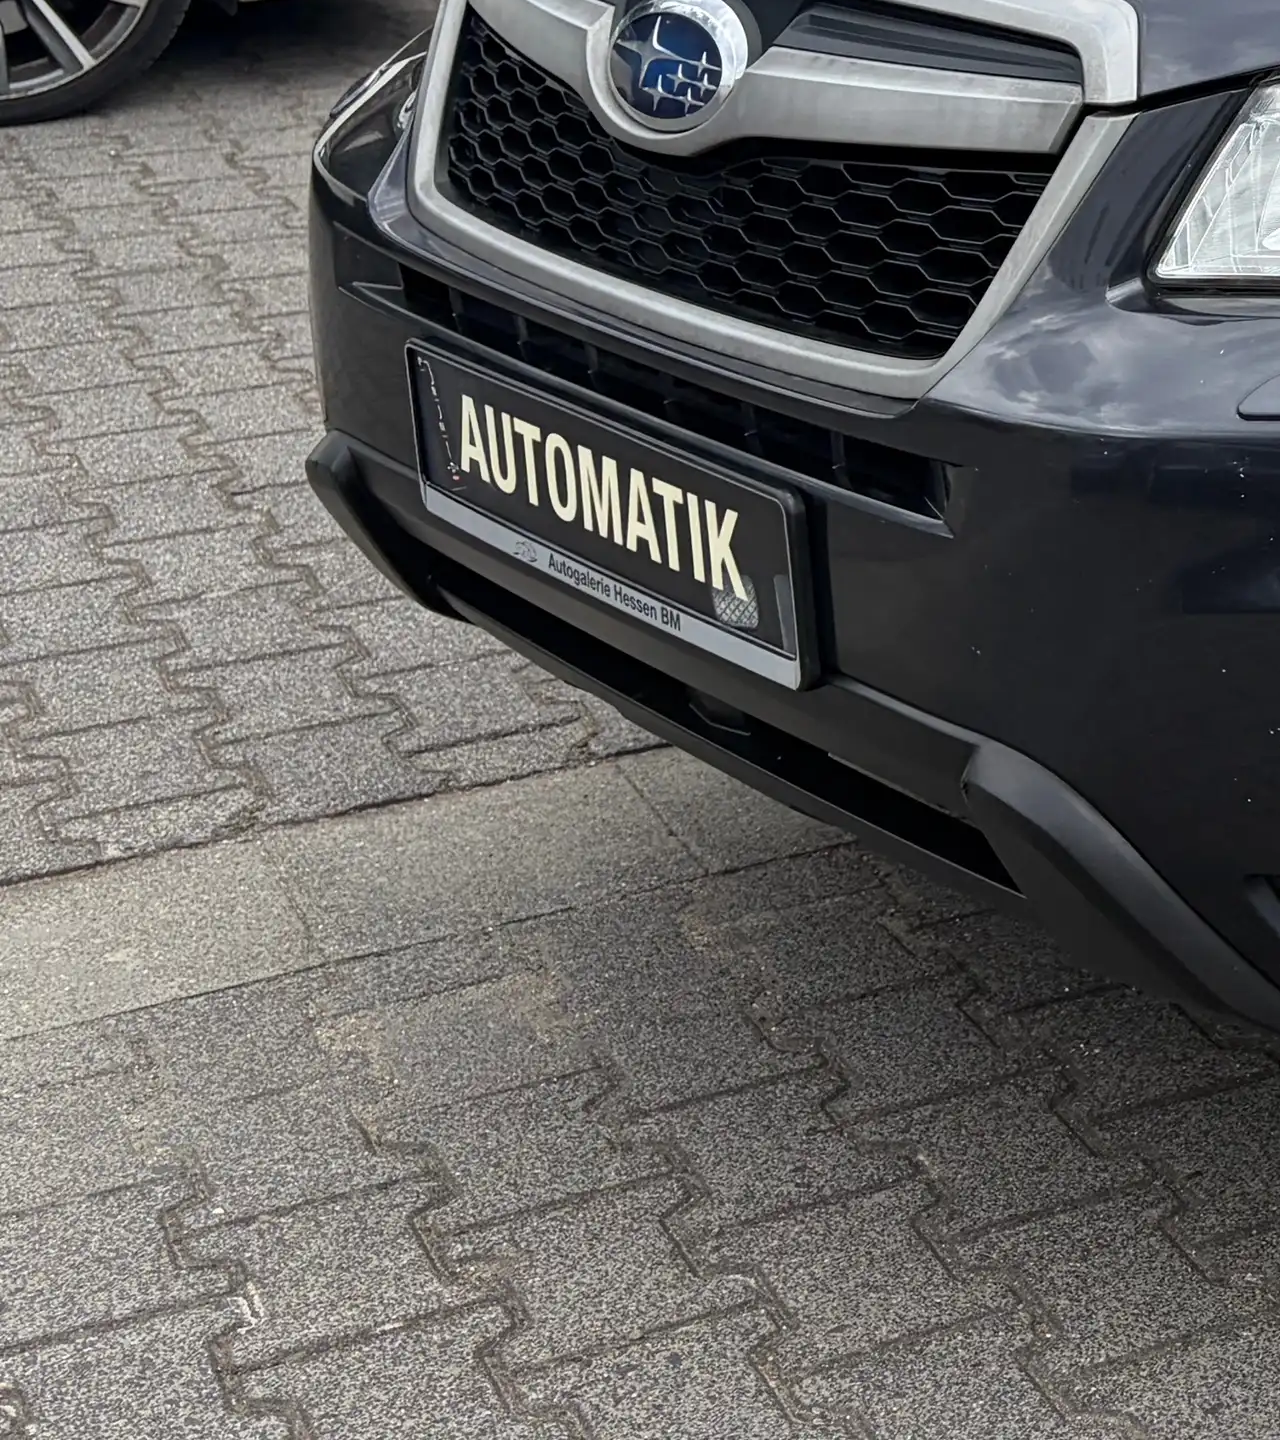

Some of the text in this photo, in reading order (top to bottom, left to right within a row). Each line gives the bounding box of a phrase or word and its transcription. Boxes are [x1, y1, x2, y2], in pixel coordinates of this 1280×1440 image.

[460, 394, 748, 602] AUTOMATIK
[548, 552, 681, 632] Autogalerie Hessen BM
